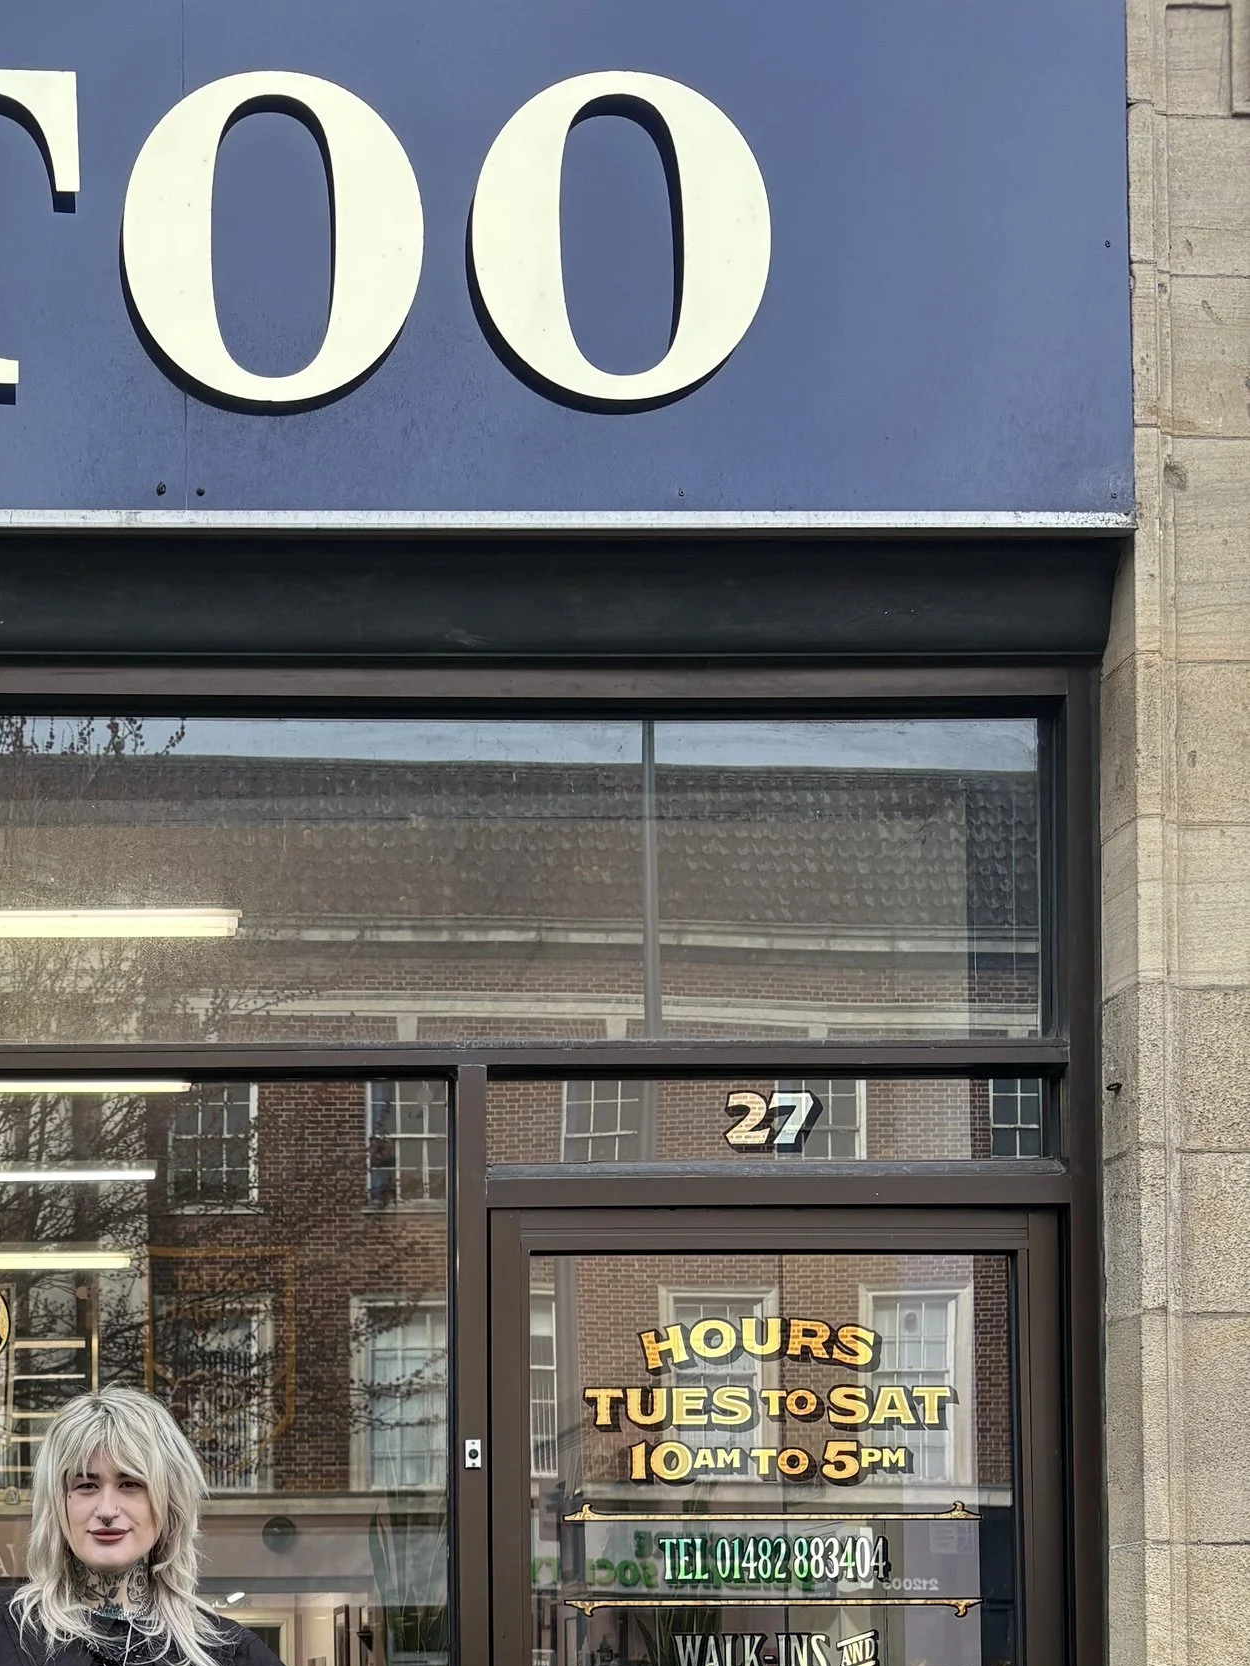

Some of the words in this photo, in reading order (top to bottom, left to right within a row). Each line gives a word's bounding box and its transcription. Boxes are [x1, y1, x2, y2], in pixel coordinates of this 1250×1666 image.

[723, 1090, 822, 1153] 27
[637, 1315, 882, 1372] HOURS
[583, 1385, 754, 1434] TUES
[760, 1387, 821, 1422] TO
[826, 1384, 960, 1434] SAT
[626, 1440, 745, 1486] 10AM
[749, 1443, 813, 1481] TO
[819, 1440, 914, 1486] 5PM
[657, 1536, 710, 1583] TEL
[714, 1536, 791, 1584] 01482
[792, 1536, 892, 1585] 883404
